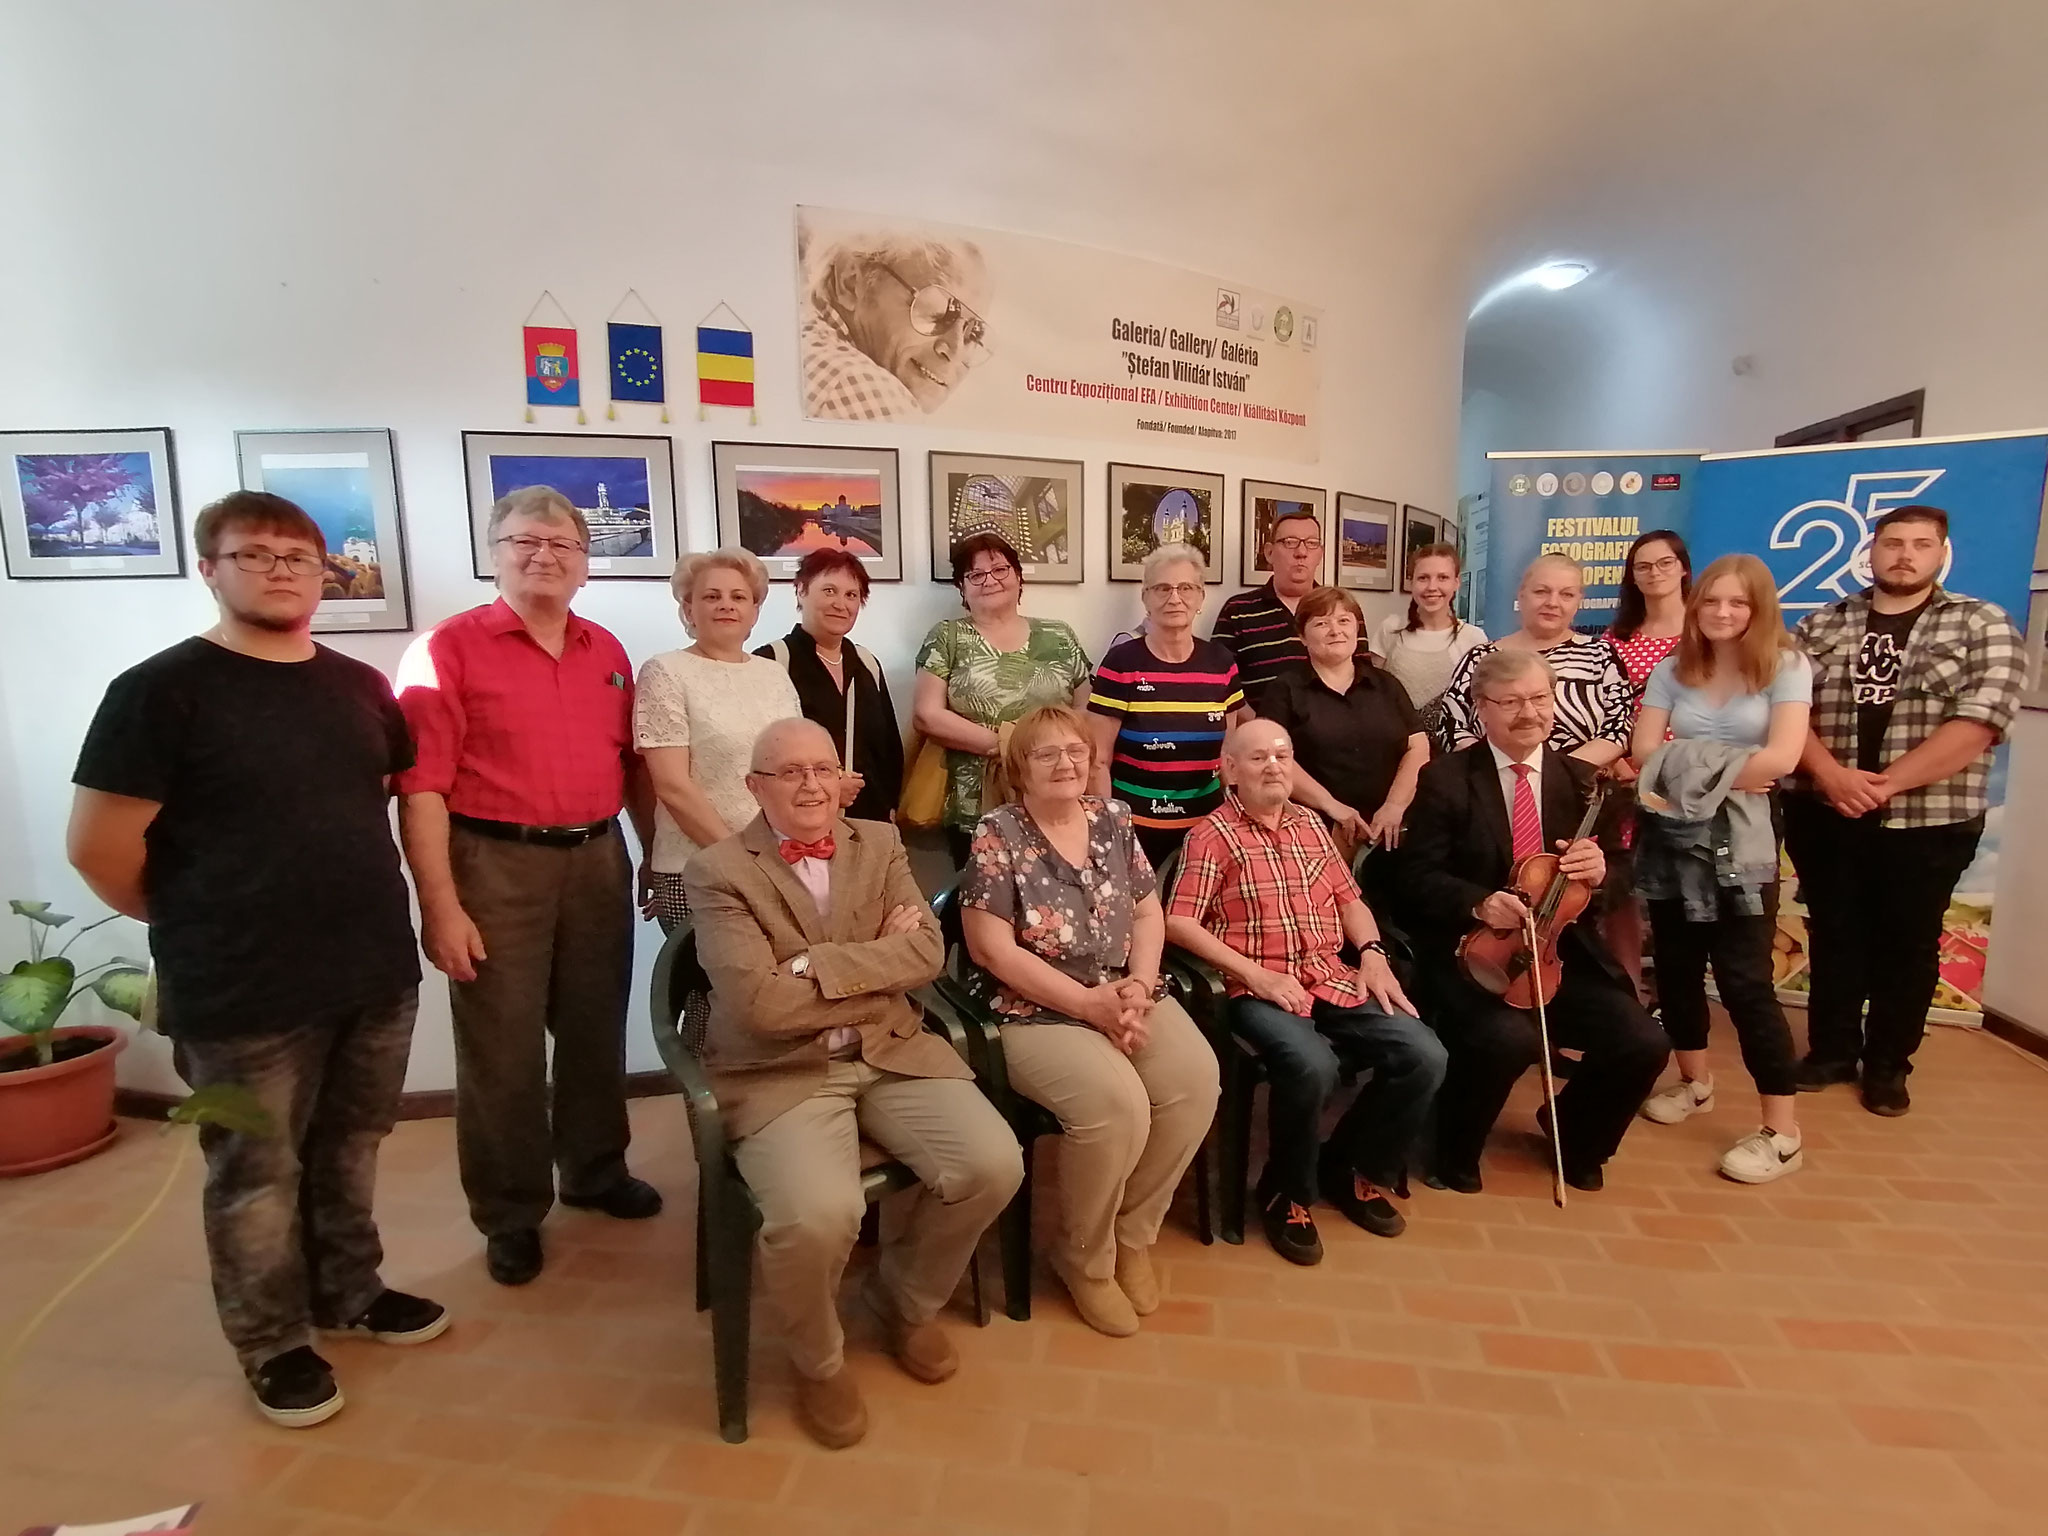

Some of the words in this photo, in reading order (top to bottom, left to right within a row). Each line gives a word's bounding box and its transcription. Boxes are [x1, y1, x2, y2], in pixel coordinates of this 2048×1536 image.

[1111, 317, 1167, 348] Galeria/
[1169, 328, 1218, 358] Gallery/
[1220, 339, 1258, 367] Galéria
[1172, 359, 1211, 386] Vilidár
[1026, 374, 1068, 395] Centru
[1140, 387, 1157, 405] EFA
[1165, 390, 1209, 412] Exhibition
[1210, 397, 1242, 416] Center/
[1167, 422, 1197, 435] Founded/
[1224, 429, 1237, 440] 2017
[1547, 516, 1641, 537] FESTIVALUL
